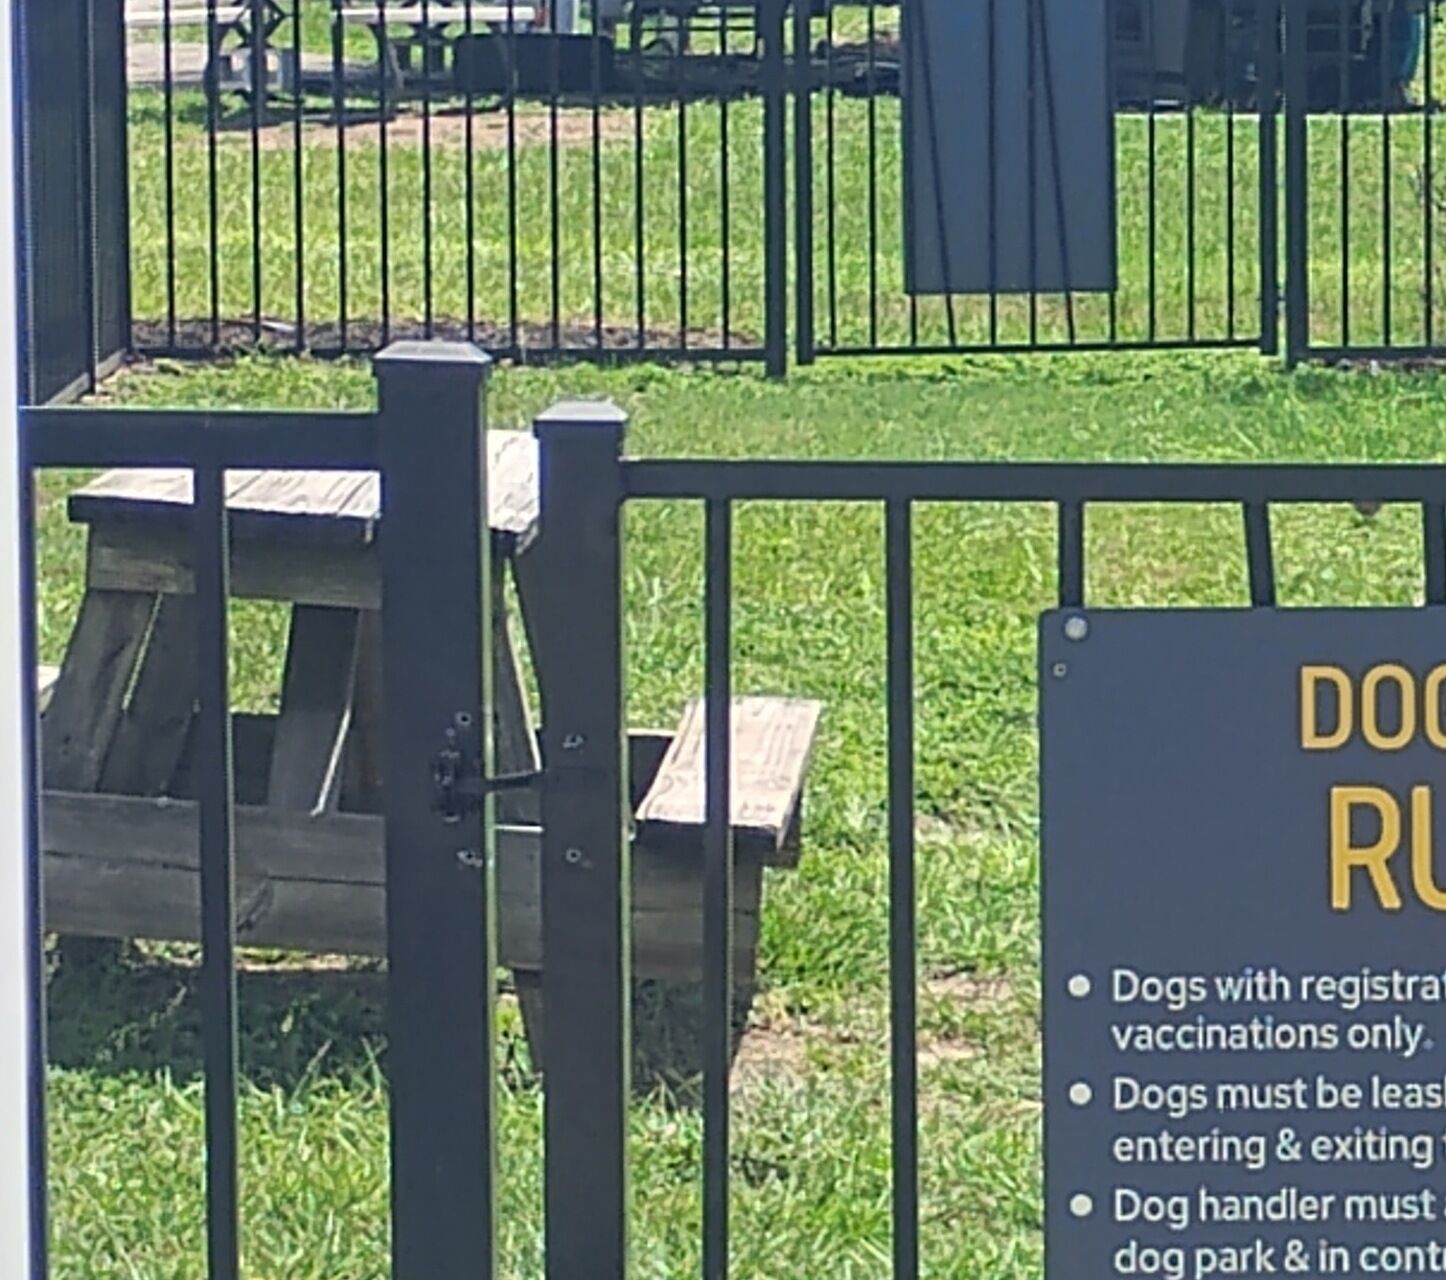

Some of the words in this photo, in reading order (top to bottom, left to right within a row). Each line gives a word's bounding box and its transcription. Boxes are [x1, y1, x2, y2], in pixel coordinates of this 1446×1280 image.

[1112, 968, 1208, 1011] Dogs
[1214, 967, 1291, 1003] with
[1111, 1014, 1339, 1051] vaccinations
[1347, 1014, 1434, 1058] only.
[1113, 1076, 1208, 1119] Dogs
[1216, 1077, 1309, 1113] must
[1316, 1074, 1363, 1109] be
[1113, 1127, 1266, 1170] entering
[1275, 1127, 1303, 1162] &
[1311, 1125, 1434, 1169] exiting
[1114, 1188, 1189, 1231] Dog
[1199, 1185, 1336, 1222] handler
[1344, 1188, 1437, 1221] must
[1283, 1238, 1310, 1273] &
[1319, 1239, 1350, 1273] in
